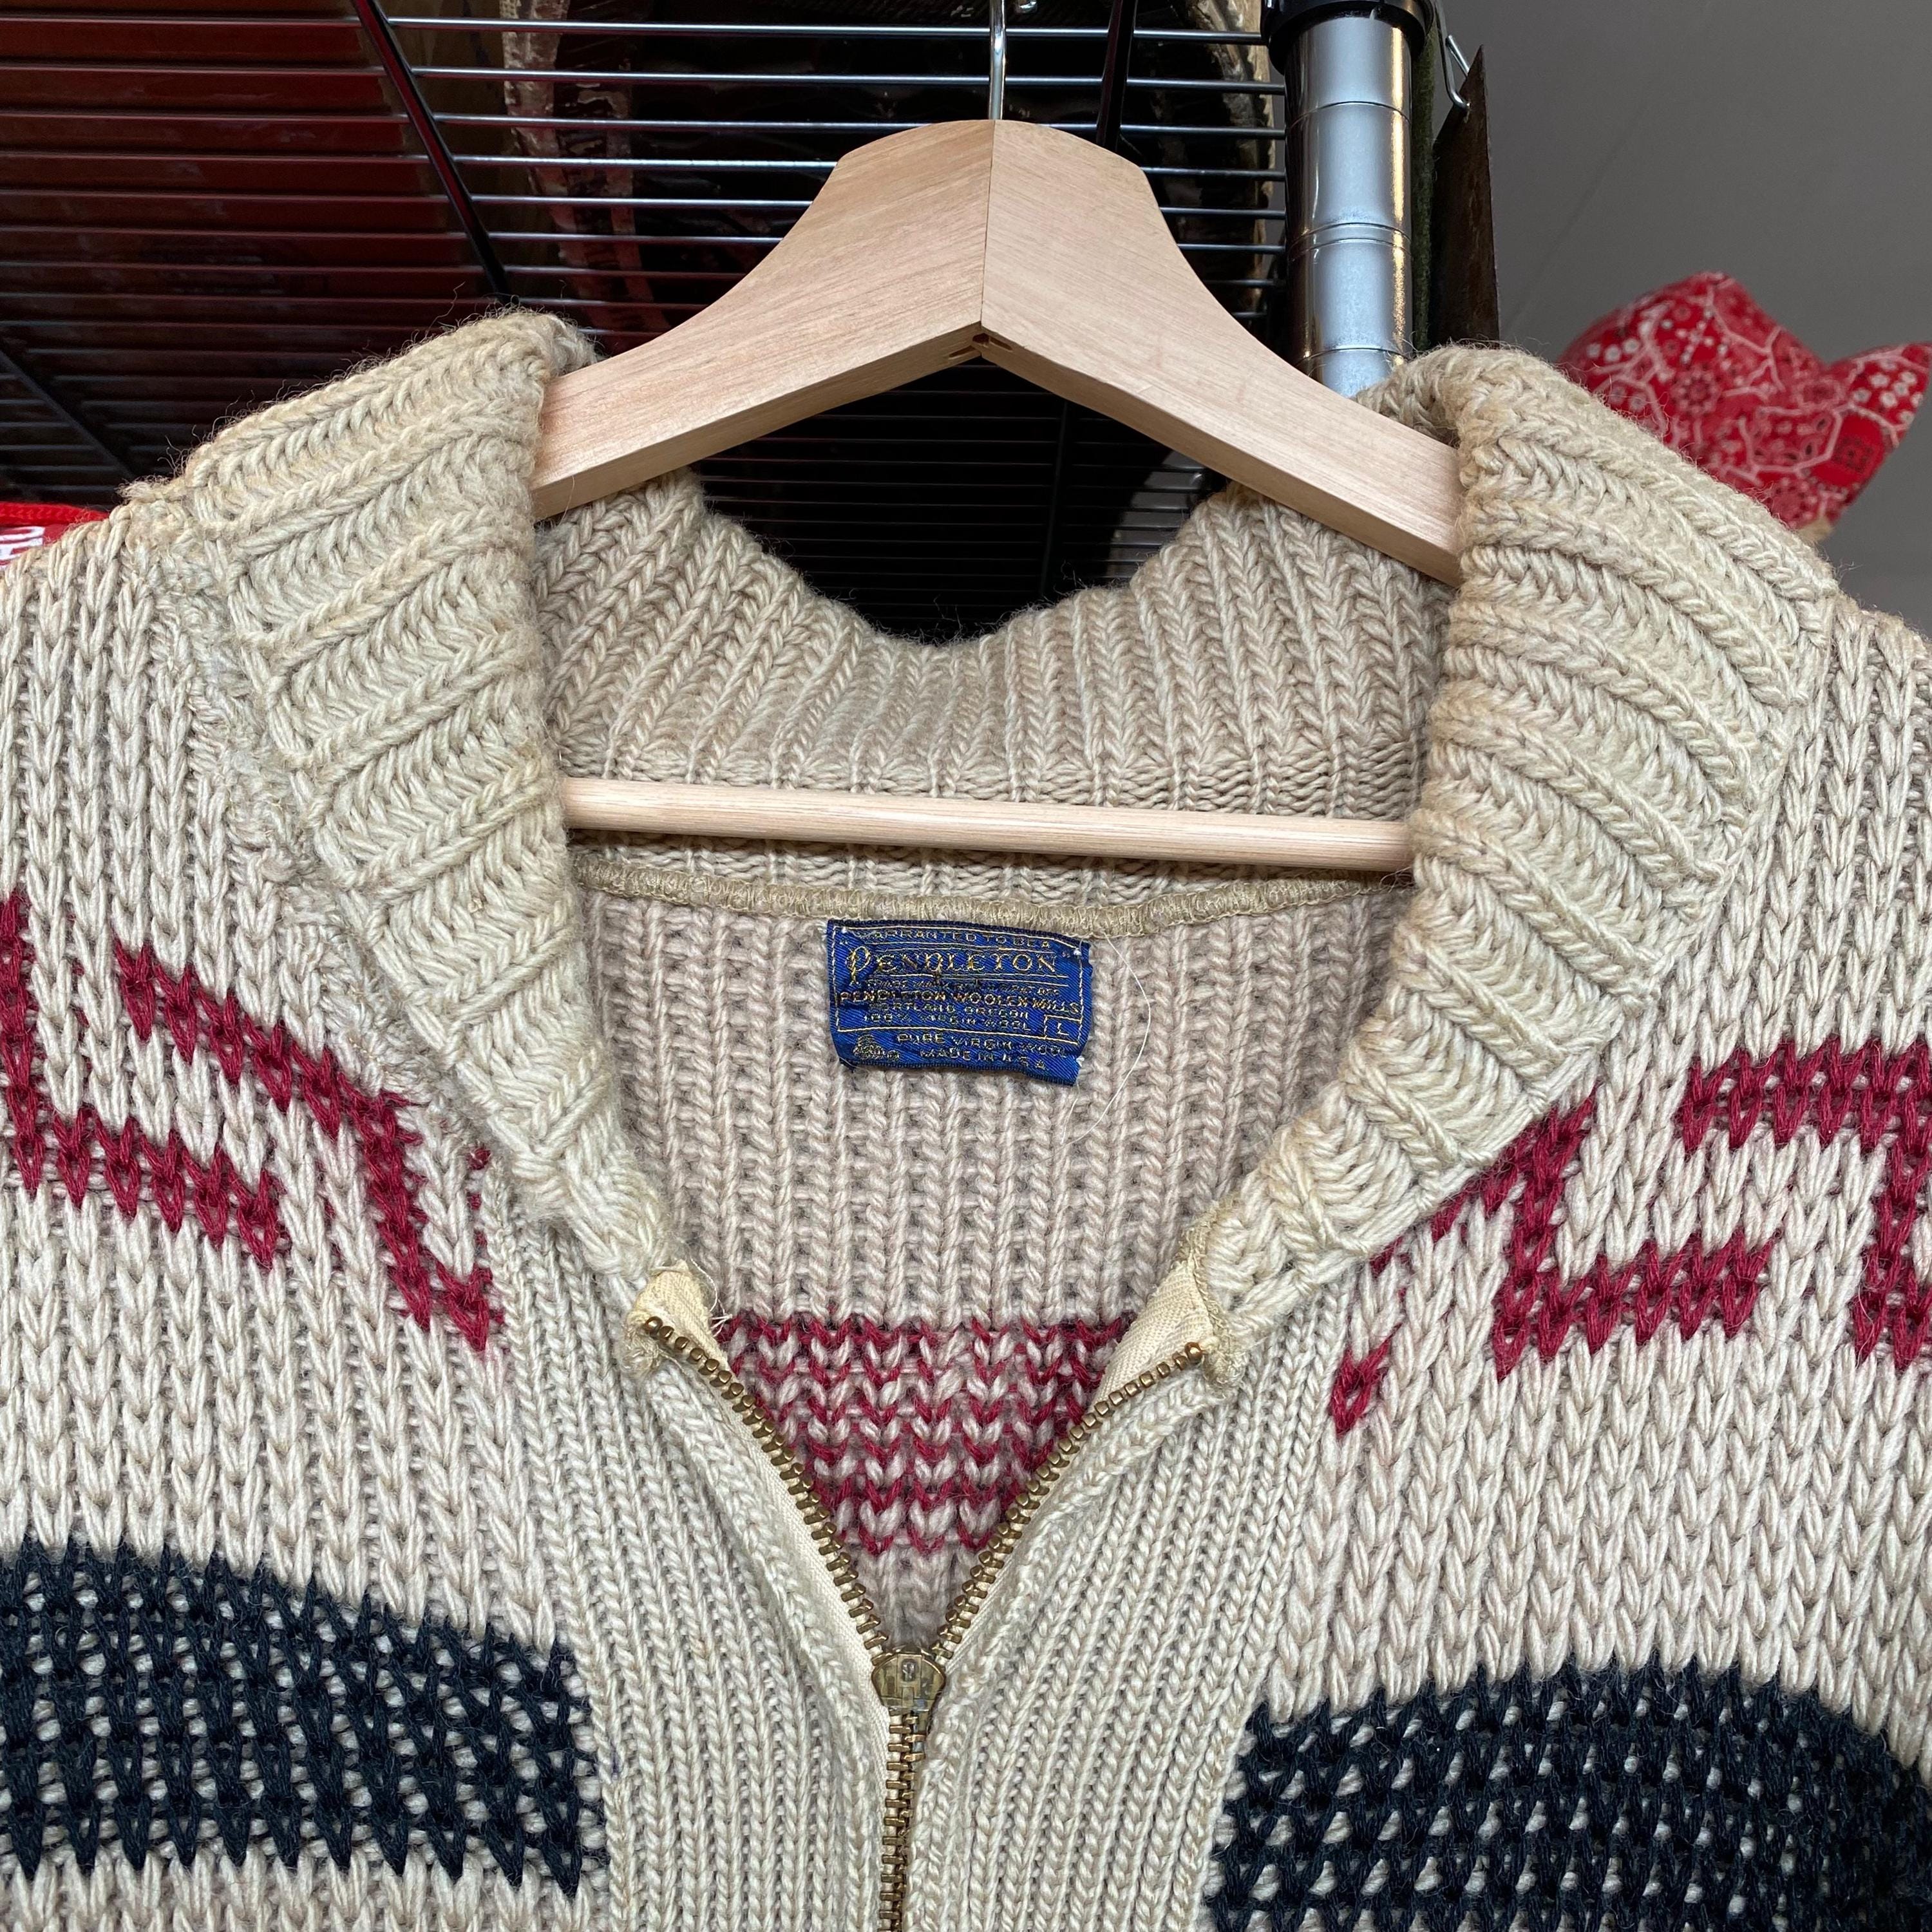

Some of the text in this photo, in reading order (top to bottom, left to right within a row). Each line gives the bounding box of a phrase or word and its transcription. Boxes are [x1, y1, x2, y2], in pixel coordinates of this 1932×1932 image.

[846, 945, 1056, 986] PENDLETON
[952, 992, 1028, 1008] WOOLEN
[1032, 998, 1080, 1014] MILLS
[1057, 1023, 1069, 1036] L
[920, 1047, 971, 1061] MADE
